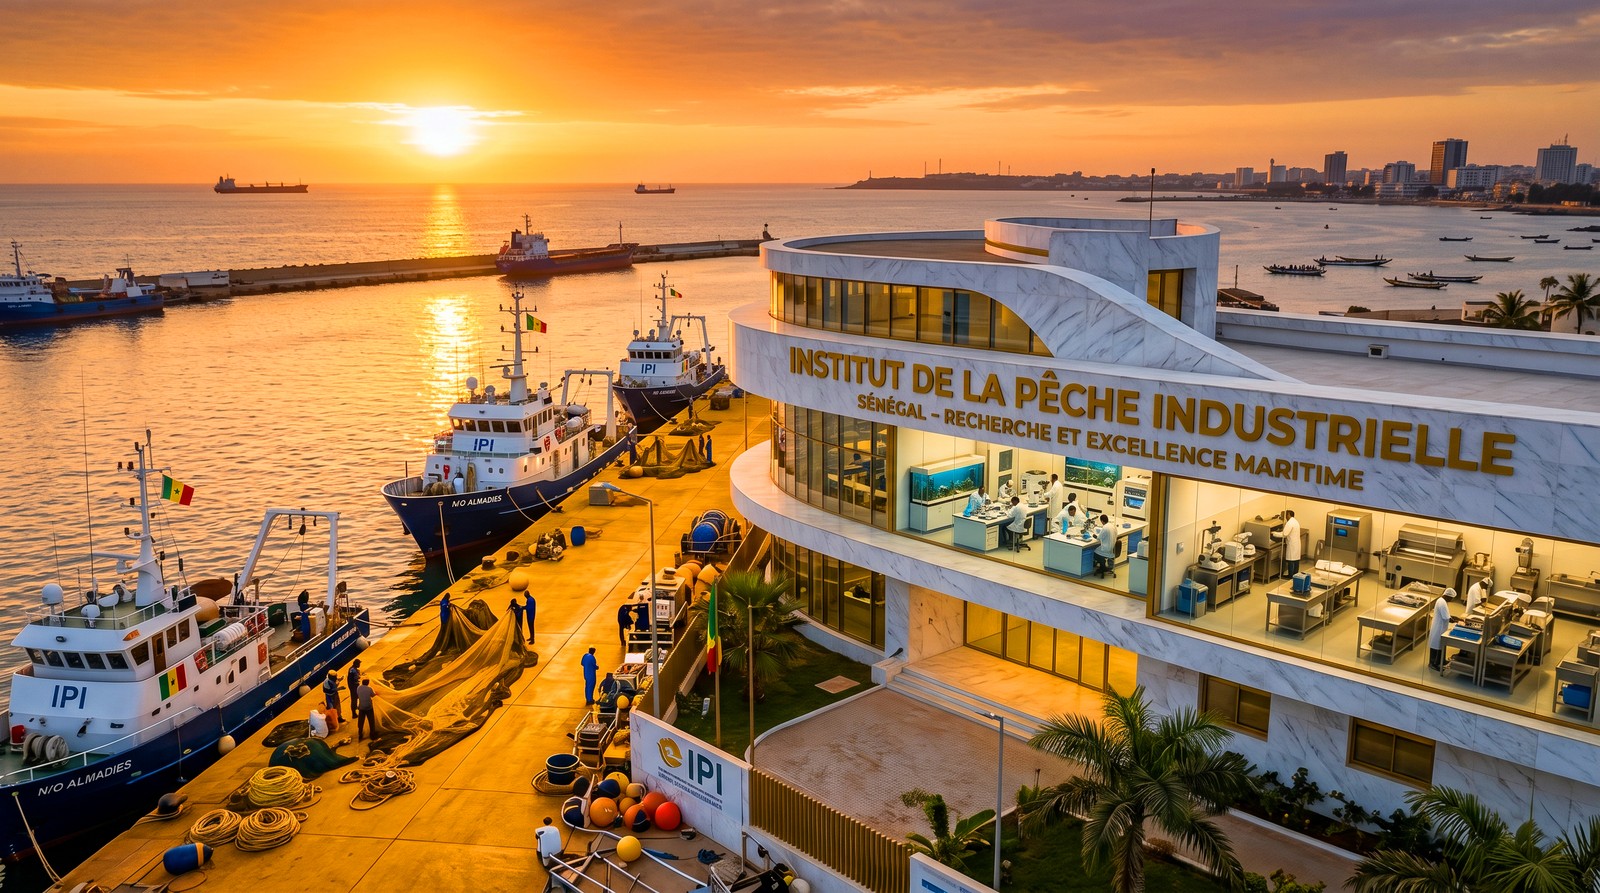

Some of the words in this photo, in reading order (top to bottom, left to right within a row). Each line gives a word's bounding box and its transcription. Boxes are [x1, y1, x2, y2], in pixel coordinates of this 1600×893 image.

[641, 364, 655, 374] IPI
[790, 346, 904, 390] INSTITUT
[913, 364, 953, 398] DE
[964, 370, 1006, 407] LA
[1016, 370, 1140, 427] PÊCHE
[1153, 394, 1516, 476] INDUSTRIELLE
[474, 438, 494, 451] IPI
[858, 392, 926, 421] SÉNÉGAL
[944, 409, 1051, 442] RECHERCHE
[1057, 428, 1081, 446] ET
[1087, 431, 1227, 470] EXCELLENCE
[1234, 453, 1364, 491] MARITIME
[467, 495, 502, 506] ALMADIES
[52, 685, 87, 709] IPI
[38, 782, 64, 797] N/O
[66, 760, 132, 789] ALMADIES
[688, 749, 722, 796] IPI
